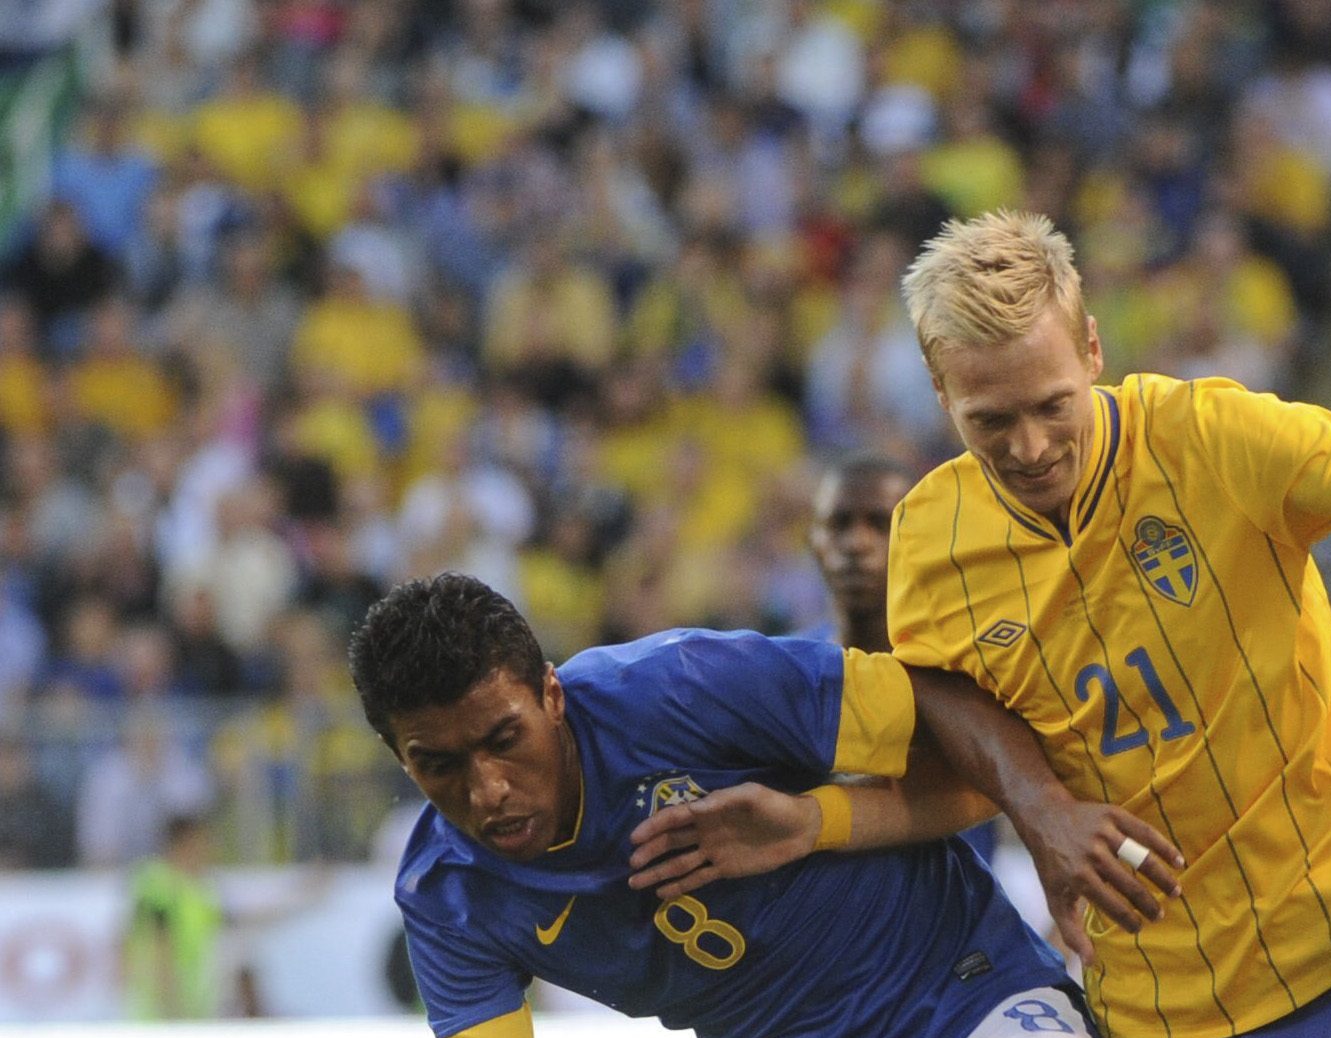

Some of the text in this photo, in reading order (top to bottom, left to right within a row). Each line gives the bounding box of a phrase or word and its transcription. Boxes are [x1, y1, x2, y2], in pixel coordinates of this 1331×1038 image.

[1075, 646, 1195, 756] 21
[654, 894, 746, 970] 8
[1004, 999, 1074, 1034] 8
